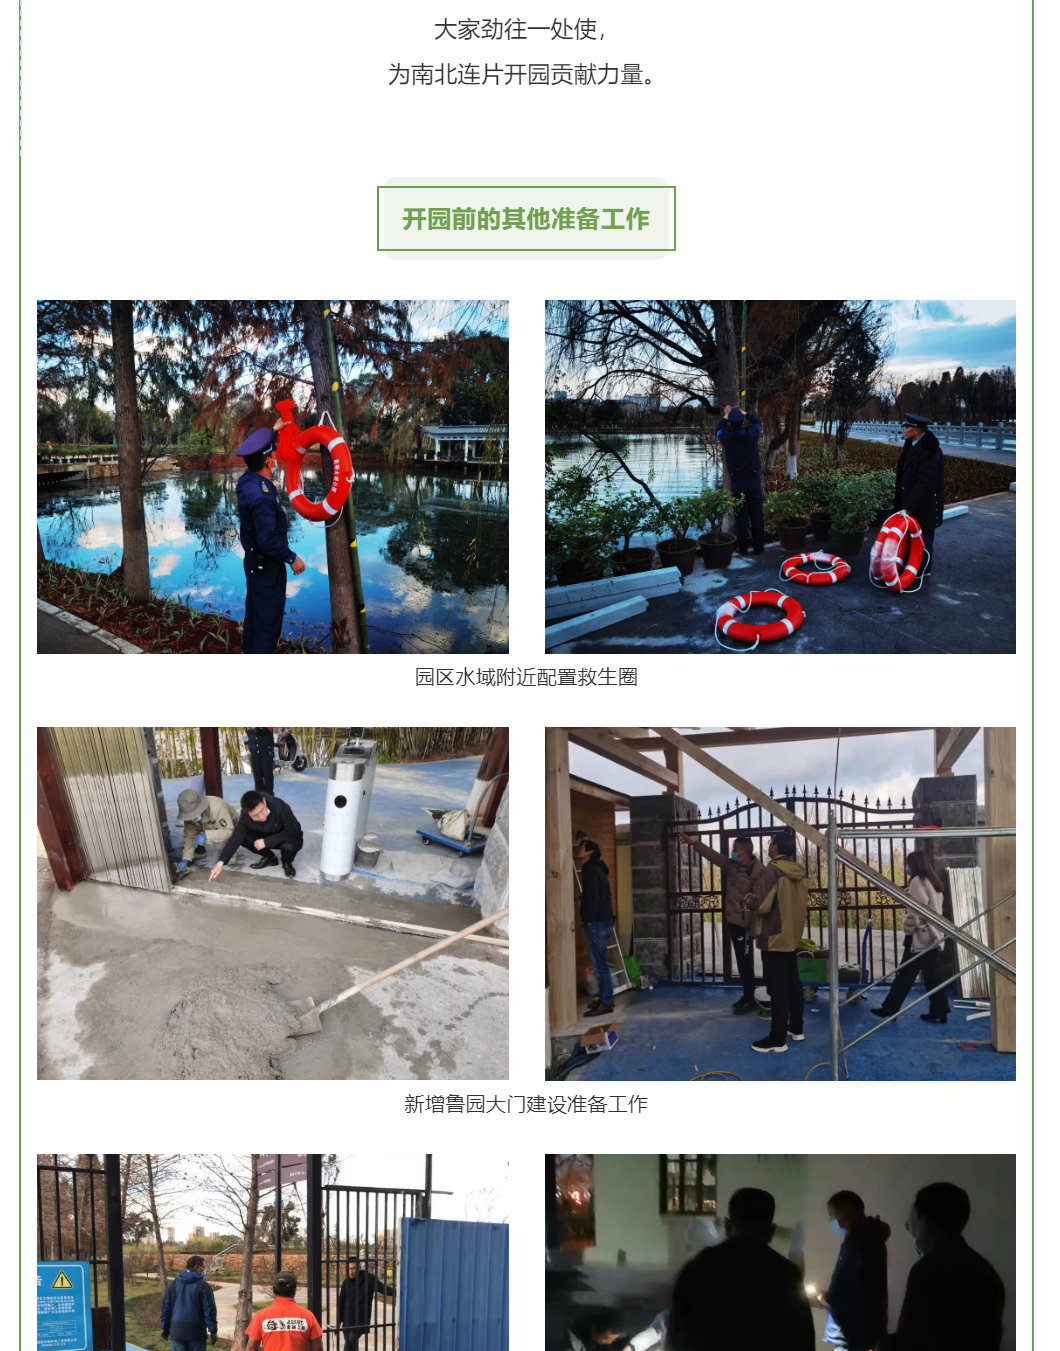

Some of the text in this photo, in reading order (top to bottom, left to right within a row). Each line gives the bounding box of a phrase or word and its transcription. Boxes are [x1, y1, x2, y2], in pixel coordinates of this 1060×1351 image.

[434, 17, 605, 41] 大家劲往一处使，
[388, 62, 652, 86] 为南北连片开园贡献力量。
[402, 206, 651, 231] 开园前的其他准备工作
